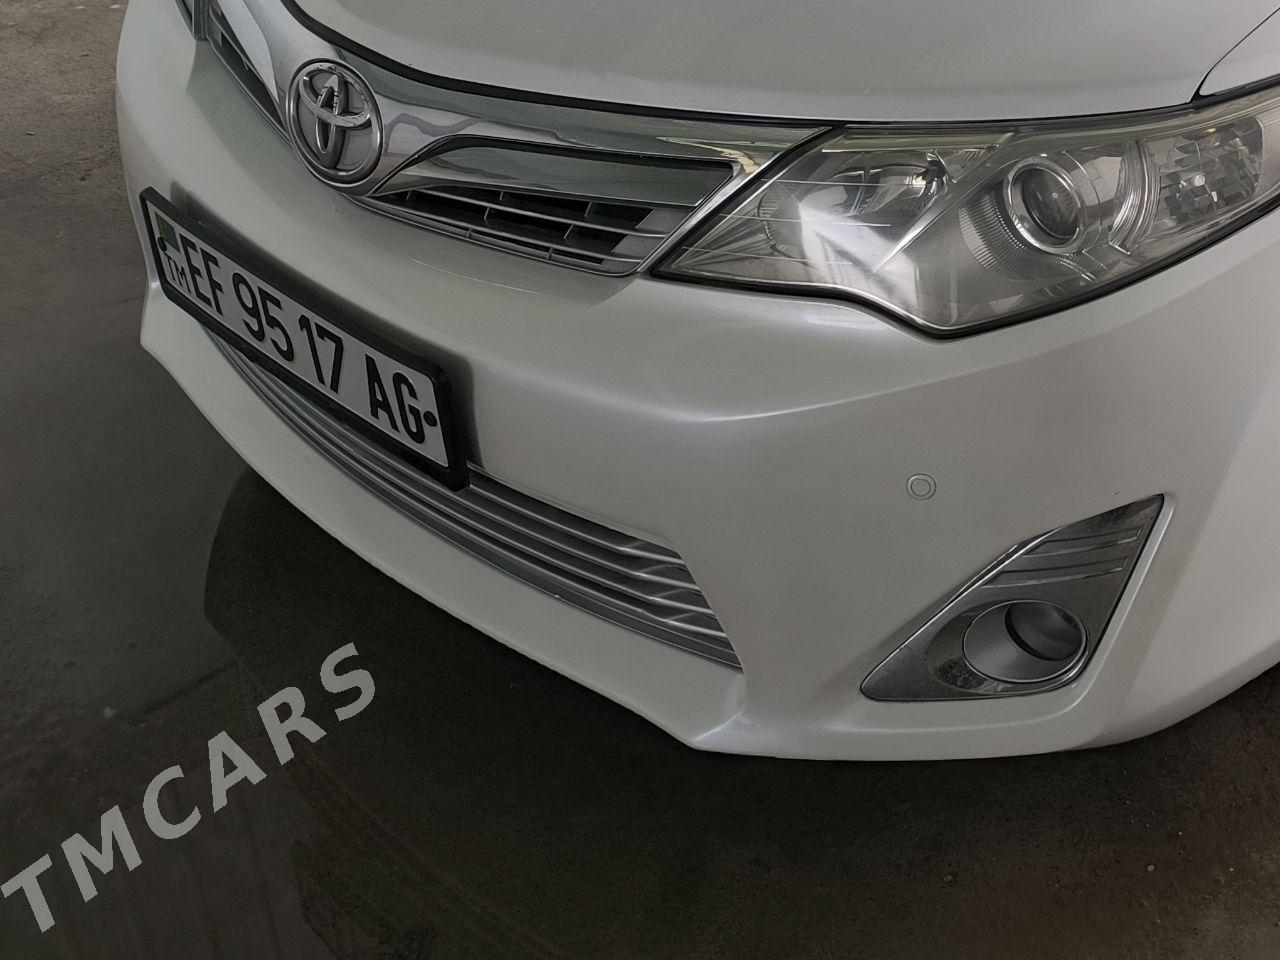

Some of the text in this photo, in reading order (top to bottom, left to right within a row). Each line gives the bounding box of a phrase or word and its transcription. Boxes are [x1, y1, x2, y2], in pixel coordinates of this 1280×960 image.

[163, 251, 192, 294] TM
[179, 232, 224, 316] EF
[365, 352, 426, 445] AG
